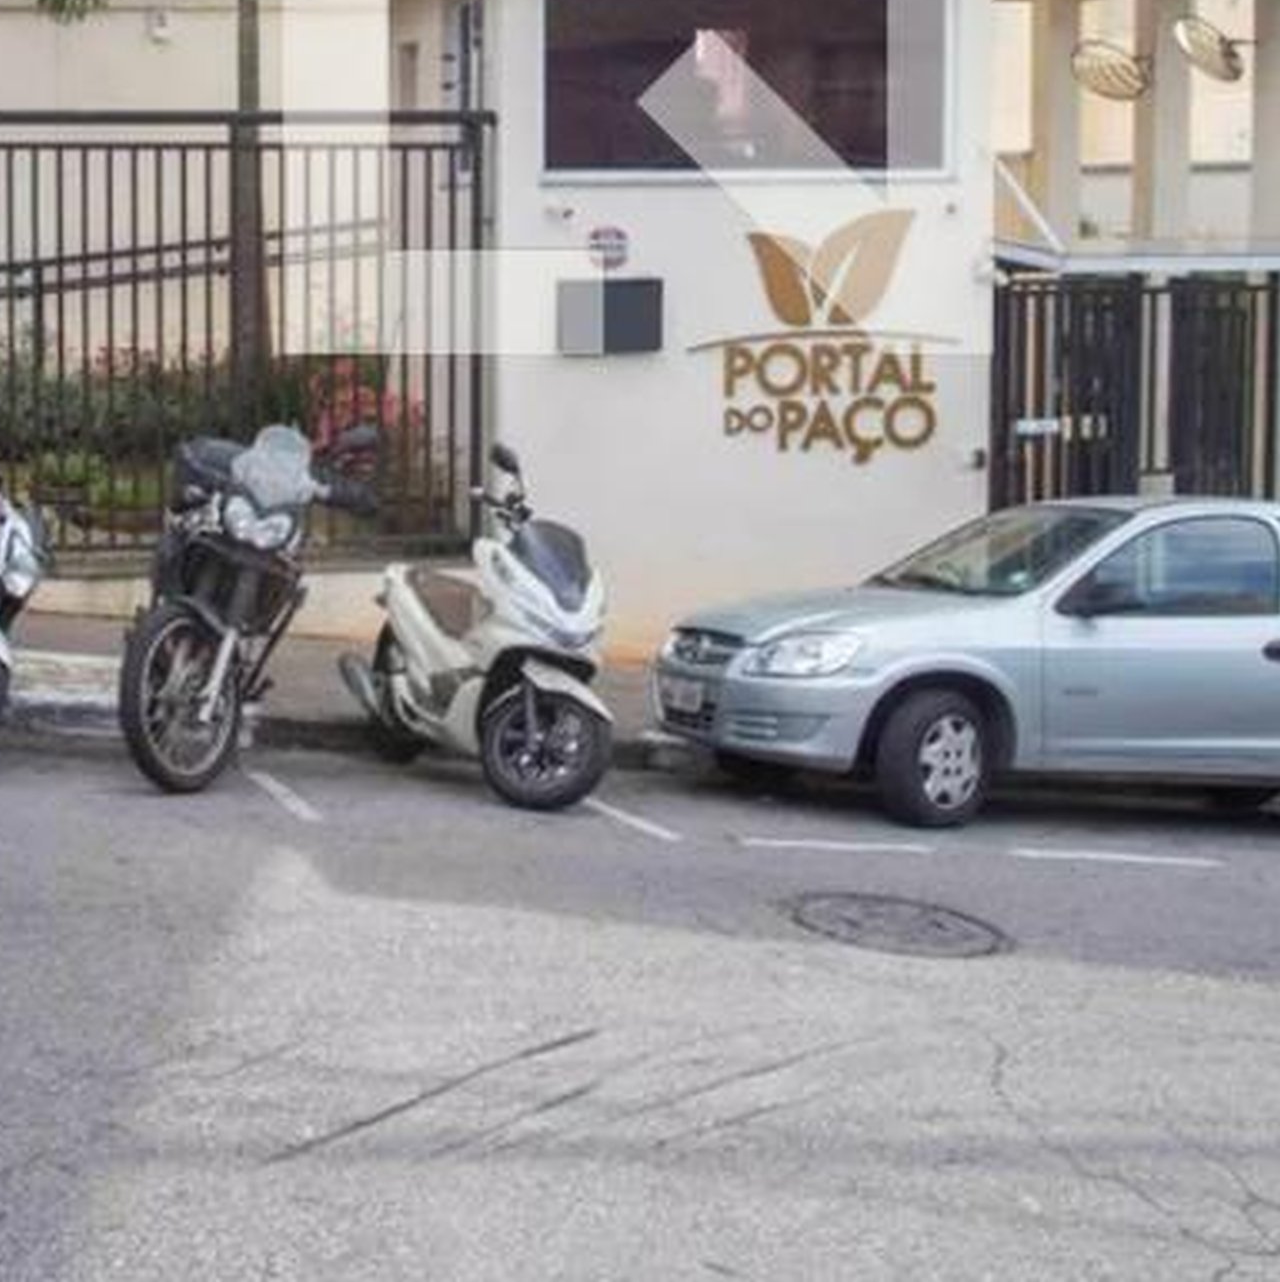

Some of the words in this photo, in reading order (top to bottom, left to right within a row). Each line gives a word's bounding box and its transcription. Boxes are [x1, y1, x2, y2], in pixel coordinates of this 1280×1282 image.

[723, 342, 936, 398] PORTAL
[723, 405, 773, 437] DO
[777, 396, 937, 465] PAÇO
